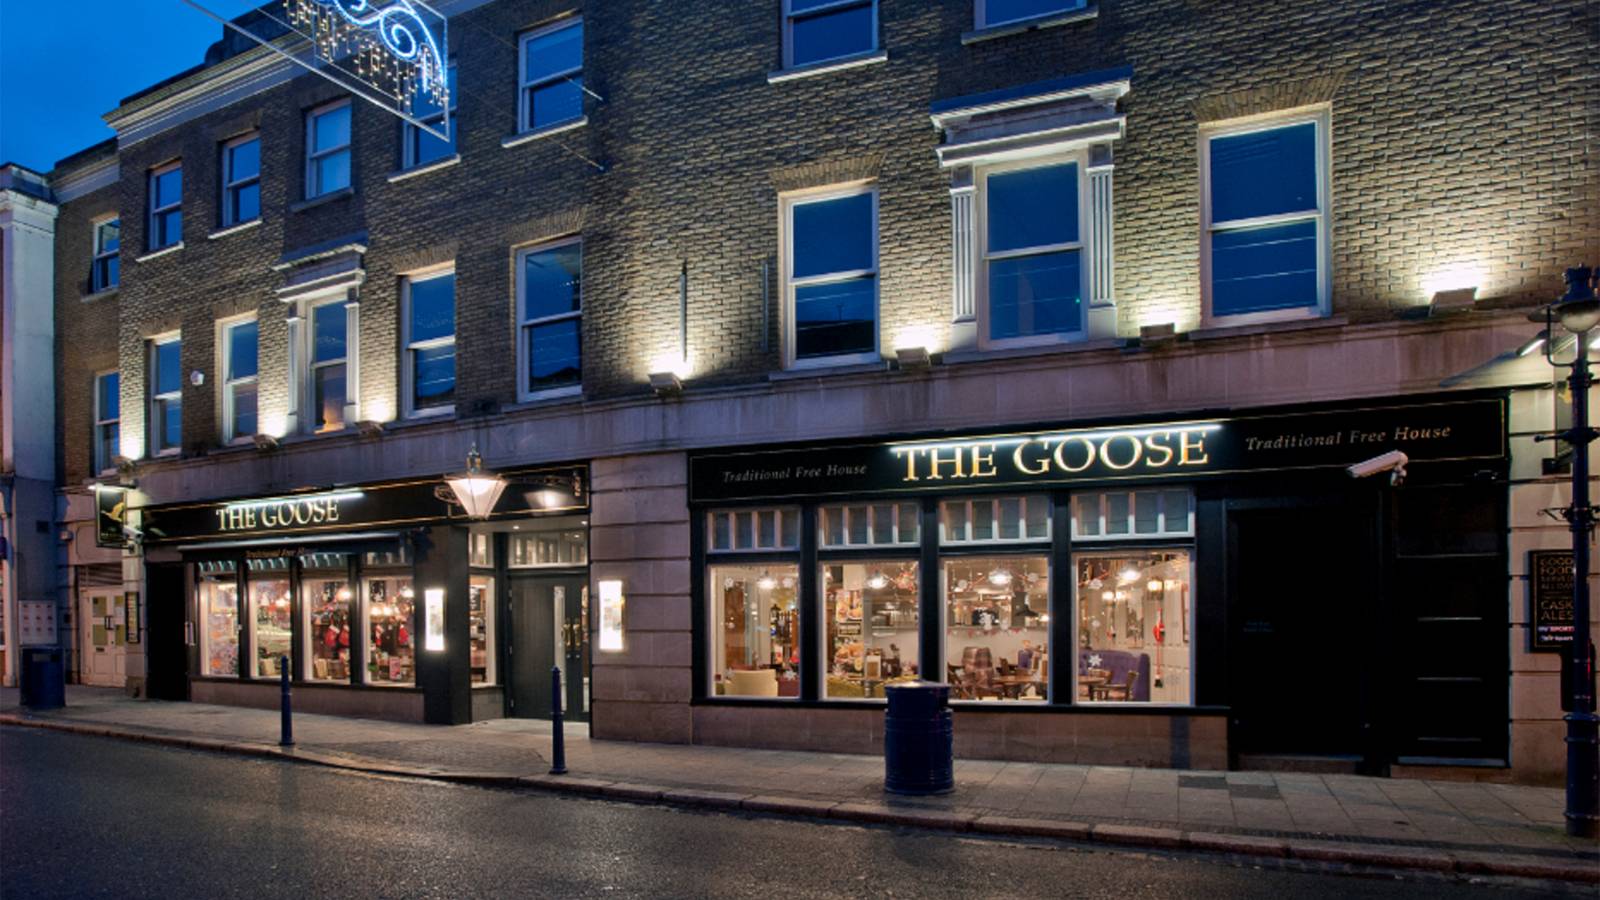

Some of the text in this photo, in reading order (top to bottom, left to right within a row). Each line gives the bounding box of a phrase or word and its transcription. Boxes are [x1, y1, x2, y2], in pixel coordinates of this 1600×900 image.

[1246, 426, 1452, 451] Traditional Free House
[897, 430, 1209, 481] THE GOOSE
[723, 464, 868, 483] Traditional Free House
[216, 499, 340, 530] THE GOOSE
[1541, 600, 1574, 609] CASK
[1541, 610, 1575, 621] ALES
